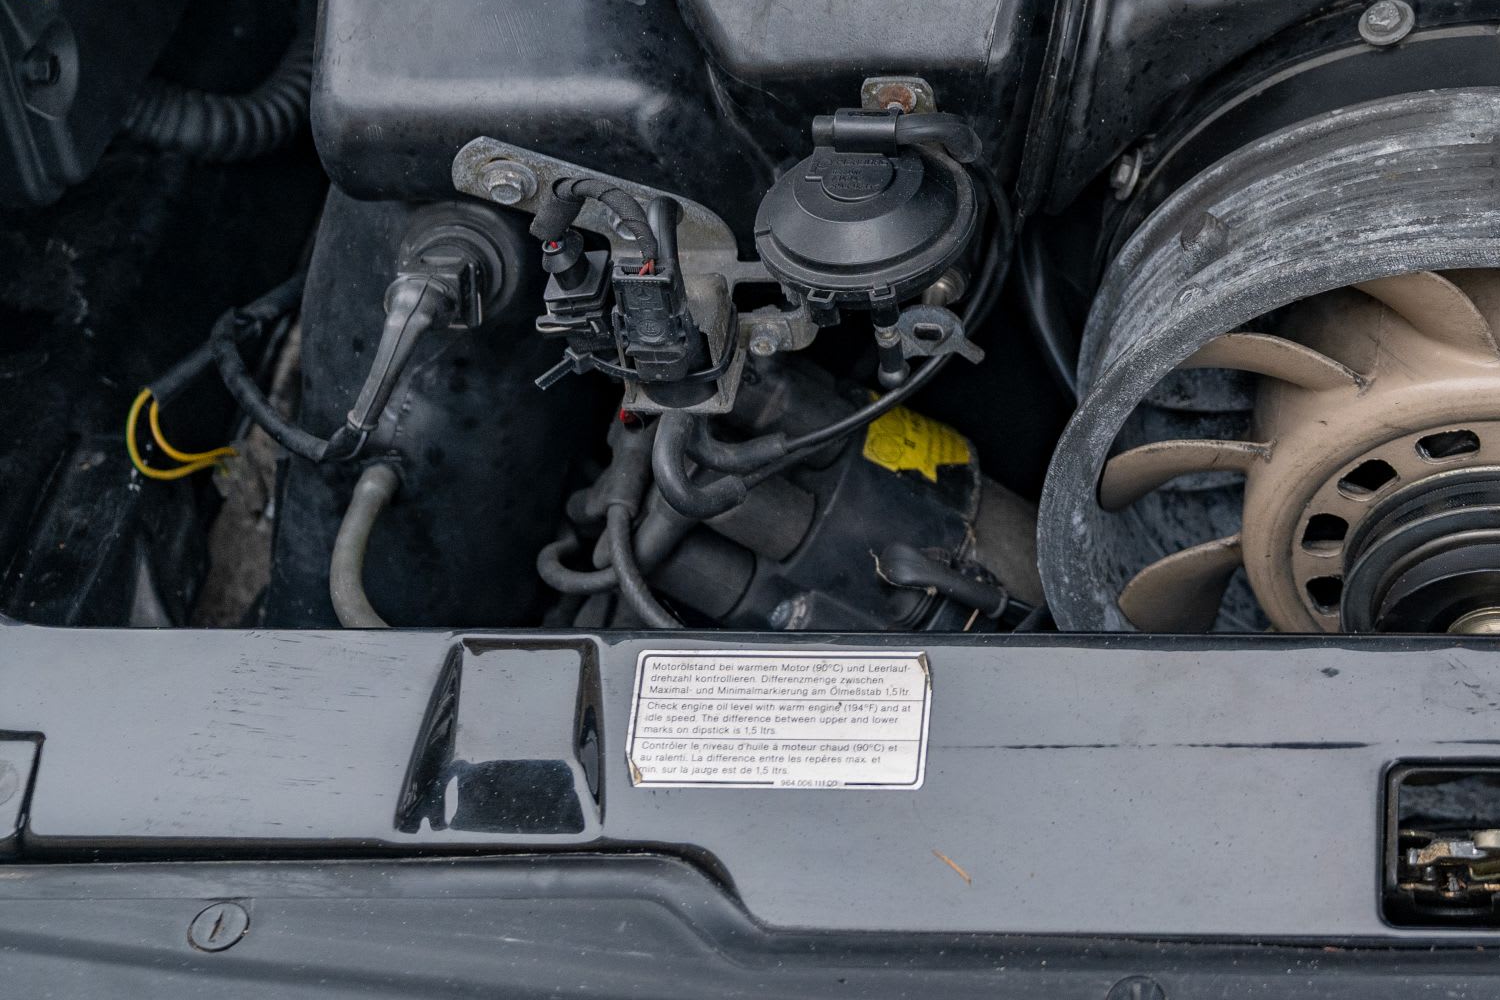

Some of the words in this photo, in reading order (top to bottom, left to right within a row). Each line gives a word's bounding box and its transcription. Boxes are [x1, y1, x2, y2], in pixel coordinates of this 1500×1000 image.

[653, 663, 715, 671] Motorölstand
[781, 664, 809, 672] Motor
[813, 664, 843, 673] (90°C)
[869, 665, 911, 673] Leerlauf-
[761, 676, 836, 684] Differenzmenge
[718, 687, 808, 696] Minimalmarkierung
[830, 686, 881, 696] Ölmeßstab
[647, 702, 677, 710] Check
[681, 702, 713, 712] engine
[717, 702, 727, 710] oil
[809, 704, 840, 713] engine
[844, 704, 877, 712] (194°F)
[820, 717, 847, 725] upper
[692, 726, 729, 735] dipstick
[642, 741, 687, 750] Contrôler
[820, 744, 849, 752] chaud
[853, 744, 884, 752] (90°C)
[692, 754, 703, 762] La
[805, 756, 841, 764] repères
[692, 766, 718, 775] jauge
